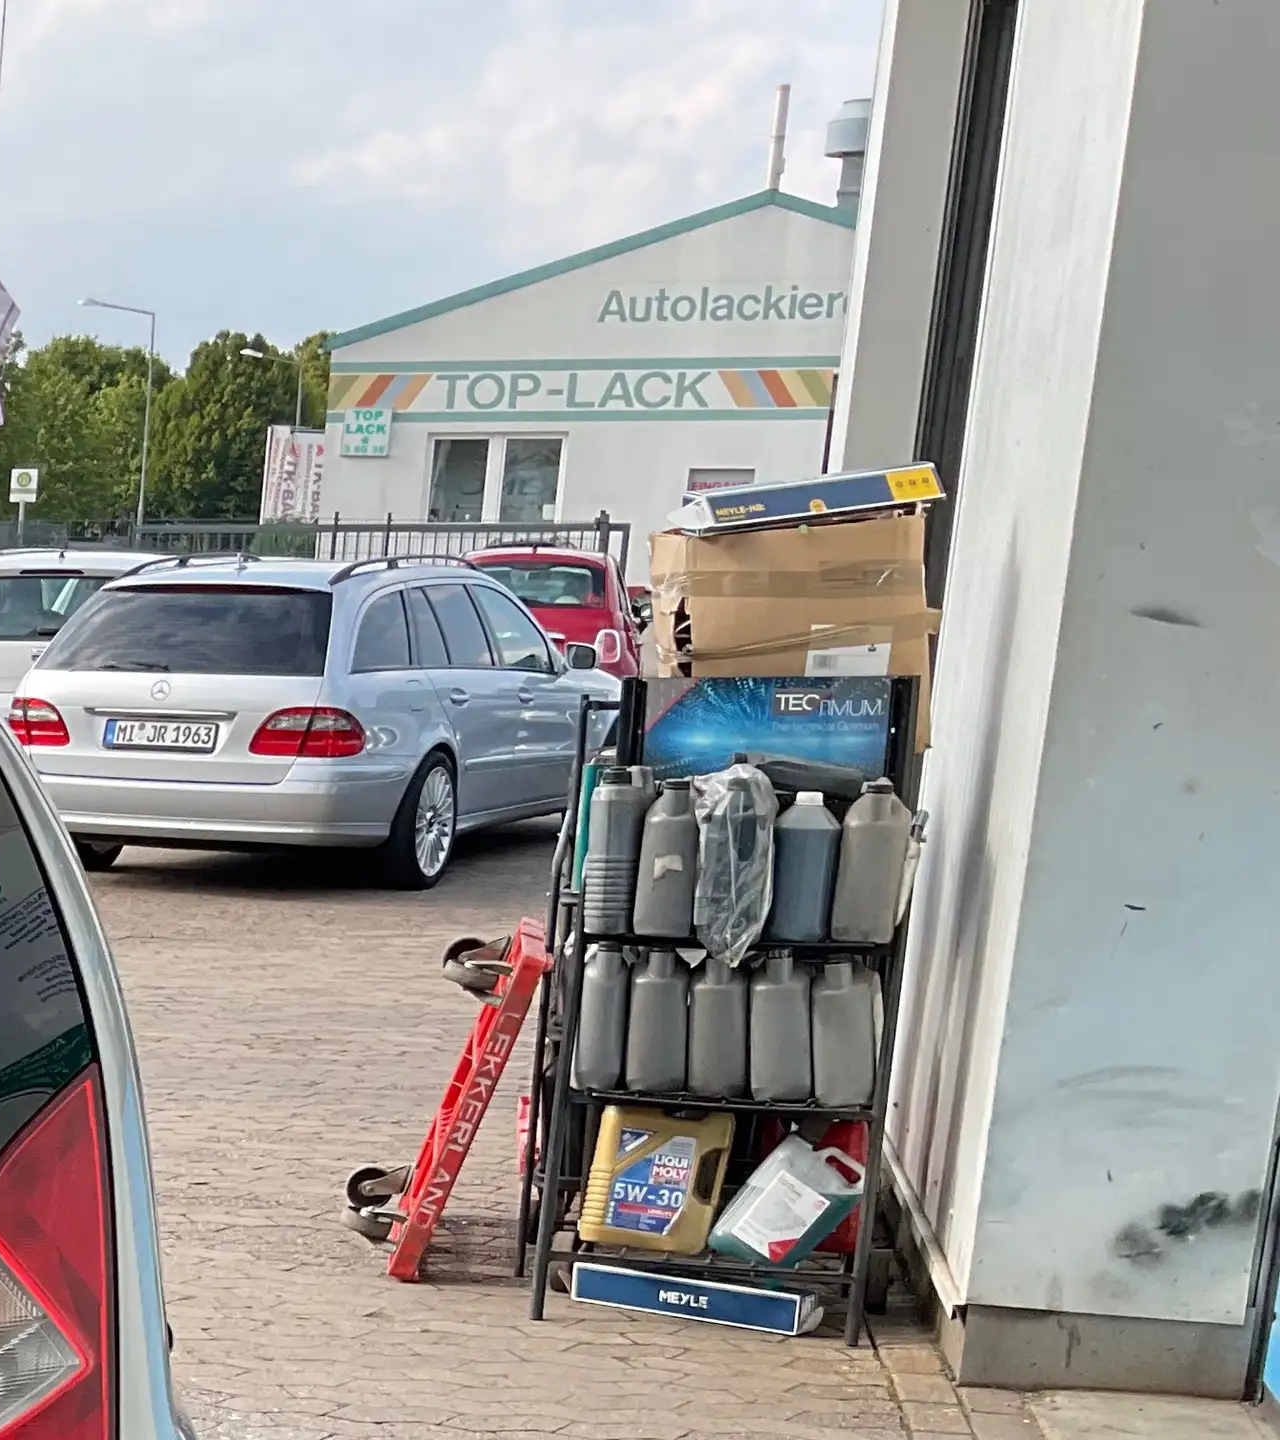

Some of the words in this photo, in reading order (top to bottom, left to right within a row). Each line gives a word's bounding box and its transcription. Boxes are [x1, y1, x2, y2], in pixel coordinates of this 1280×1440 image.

[597, 285, 848, 323] Autolackier
[436, 371, 711, 410] TOP-LACK
[352, 410, 384, 421] TOP
[346, 424, 386, 435] LACK
[281, 459, 298, 519] TK-BA
[115, 724, 136, 742] MI
[146, 725, 168, 743] JR
[170, 725, 213, 744] 1963
[413, 1010, 523, 1230] LEKKERLAND
[654, 1154, 689, 1168] LIQUI
[652, 1166, 688, 1180] MOLY
[613, 1182, 683, 1208] 5W-30
[658, 1289, 709, 1309] MEYLE
